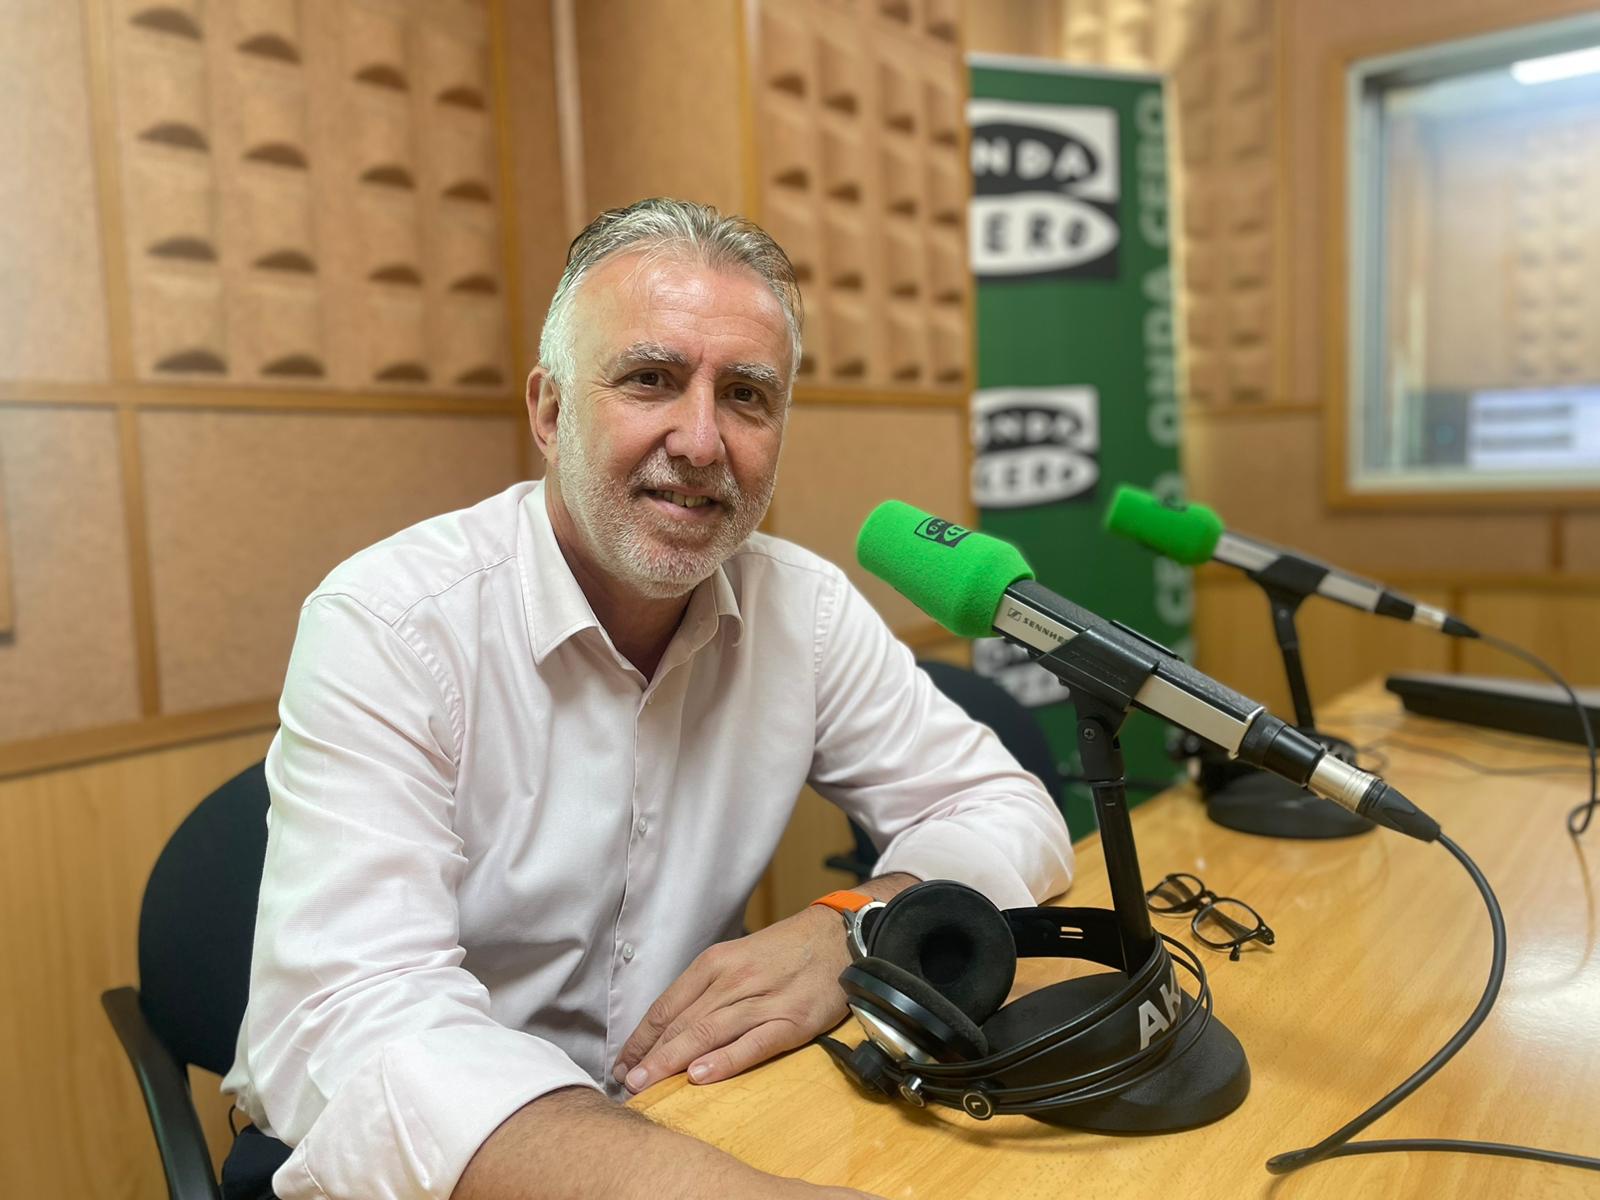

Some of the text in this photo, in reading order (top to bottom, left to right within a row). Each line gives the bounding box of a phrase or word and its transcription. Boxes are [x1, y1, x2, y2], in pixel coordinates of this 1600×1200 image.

[970, 136, 1092, 182] NDA
[982, 210, 1089, 256] ERO
[1023, 617, 1066, 643] SENNHE
[1138, 966, 1181, 1051] AK
